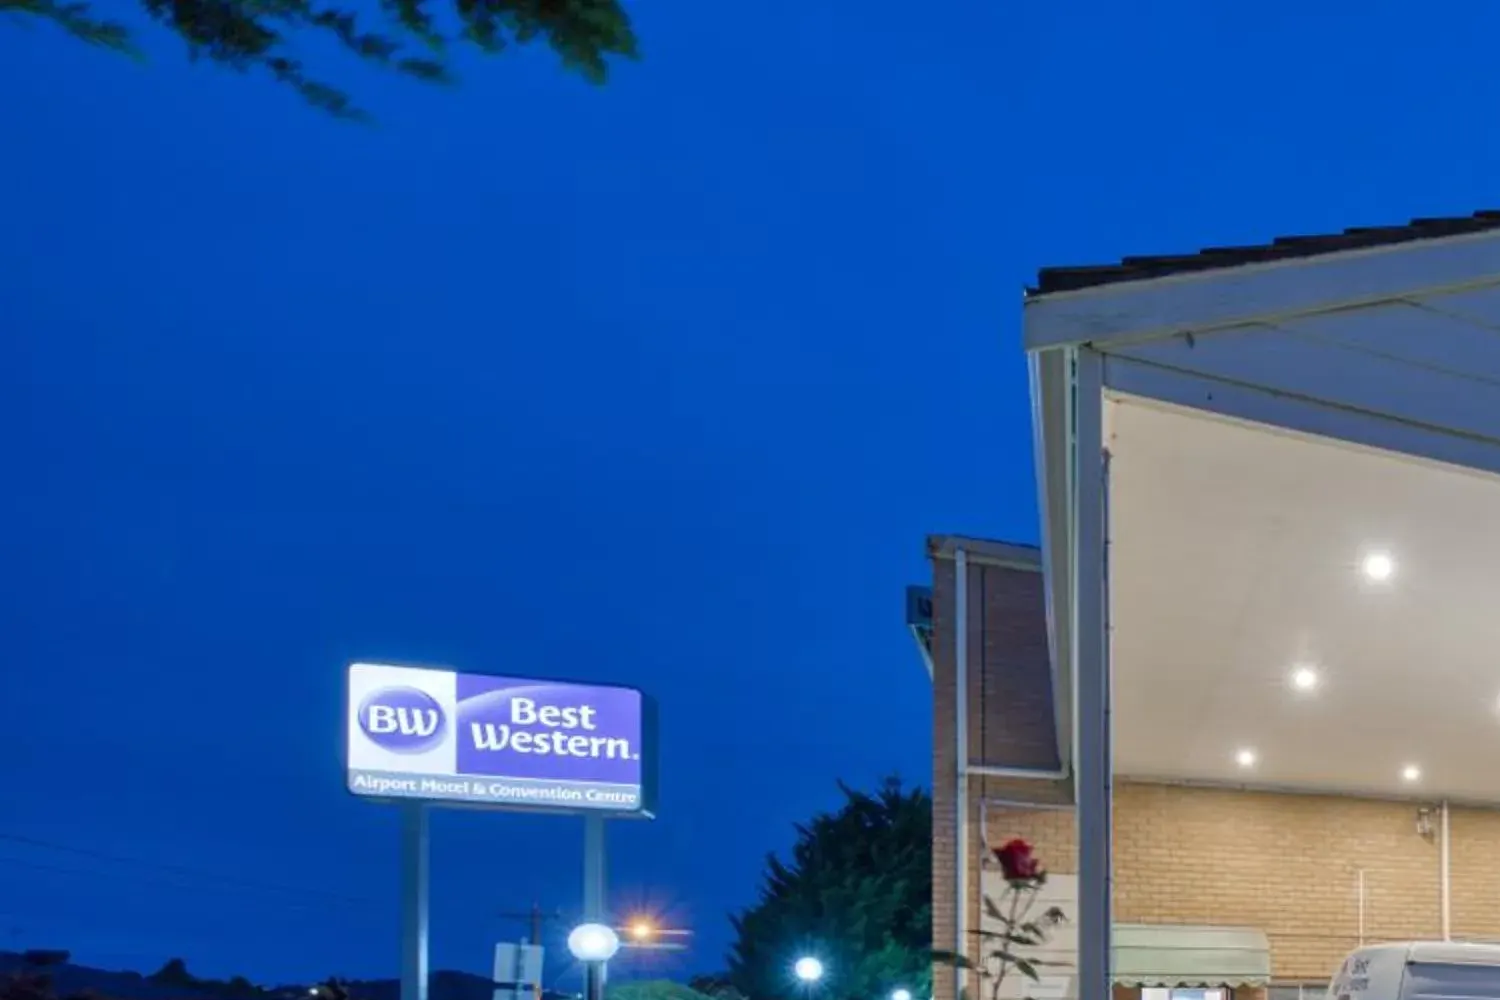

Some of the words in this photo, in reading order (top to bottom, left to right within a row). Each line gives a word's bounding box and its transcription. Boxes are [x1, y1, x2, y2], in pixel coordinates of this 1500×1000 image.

[368, 705, 439, 737] BW
[511, 697, 596, 730] Best
[353, 775, 417, 793] Airport
[473, 783, 486, 796] &
[489, 783, 582, 801] Convention
[586, 788, 638, 803] Centre
